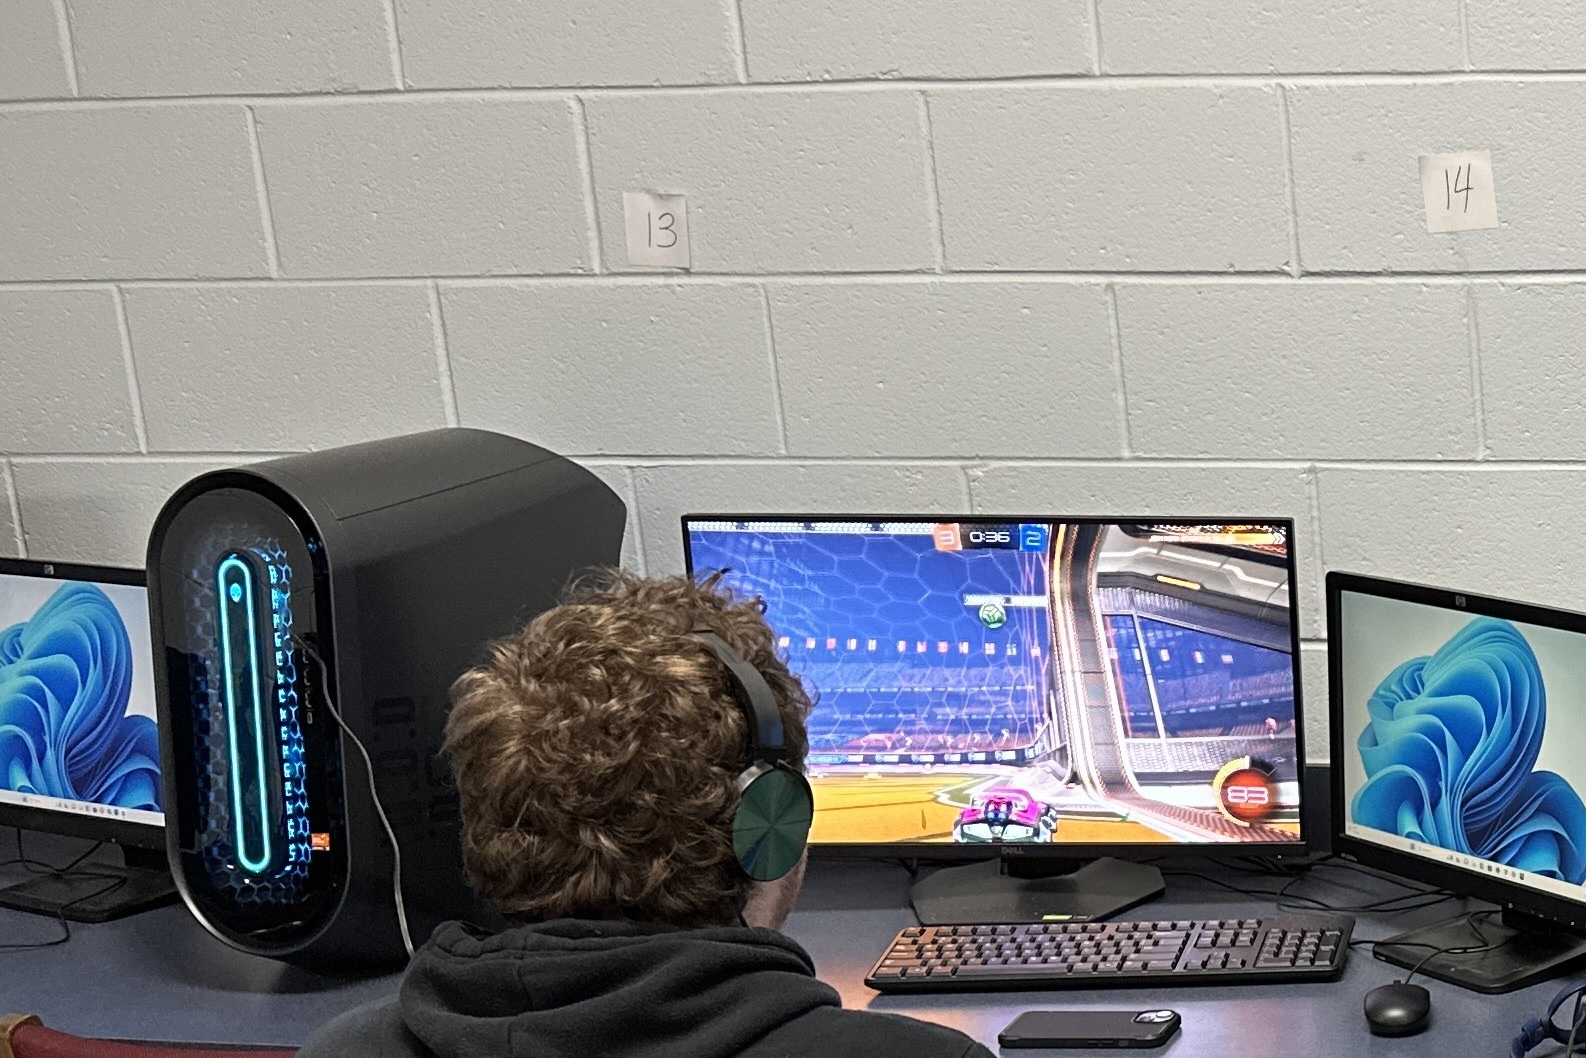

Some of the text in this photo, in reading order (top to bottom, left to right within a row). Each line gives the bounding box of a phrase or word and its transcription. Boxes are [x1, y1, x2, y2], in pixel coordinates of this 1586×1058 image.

[1445, 164, 1474, 213] 14
[646, 212, 678, 249] 13
[939, 531, 1041, 546] 3 0:36 2
[1227, 786, 1269, 804] 83
[1001, 847, 1025, 855] DELL
